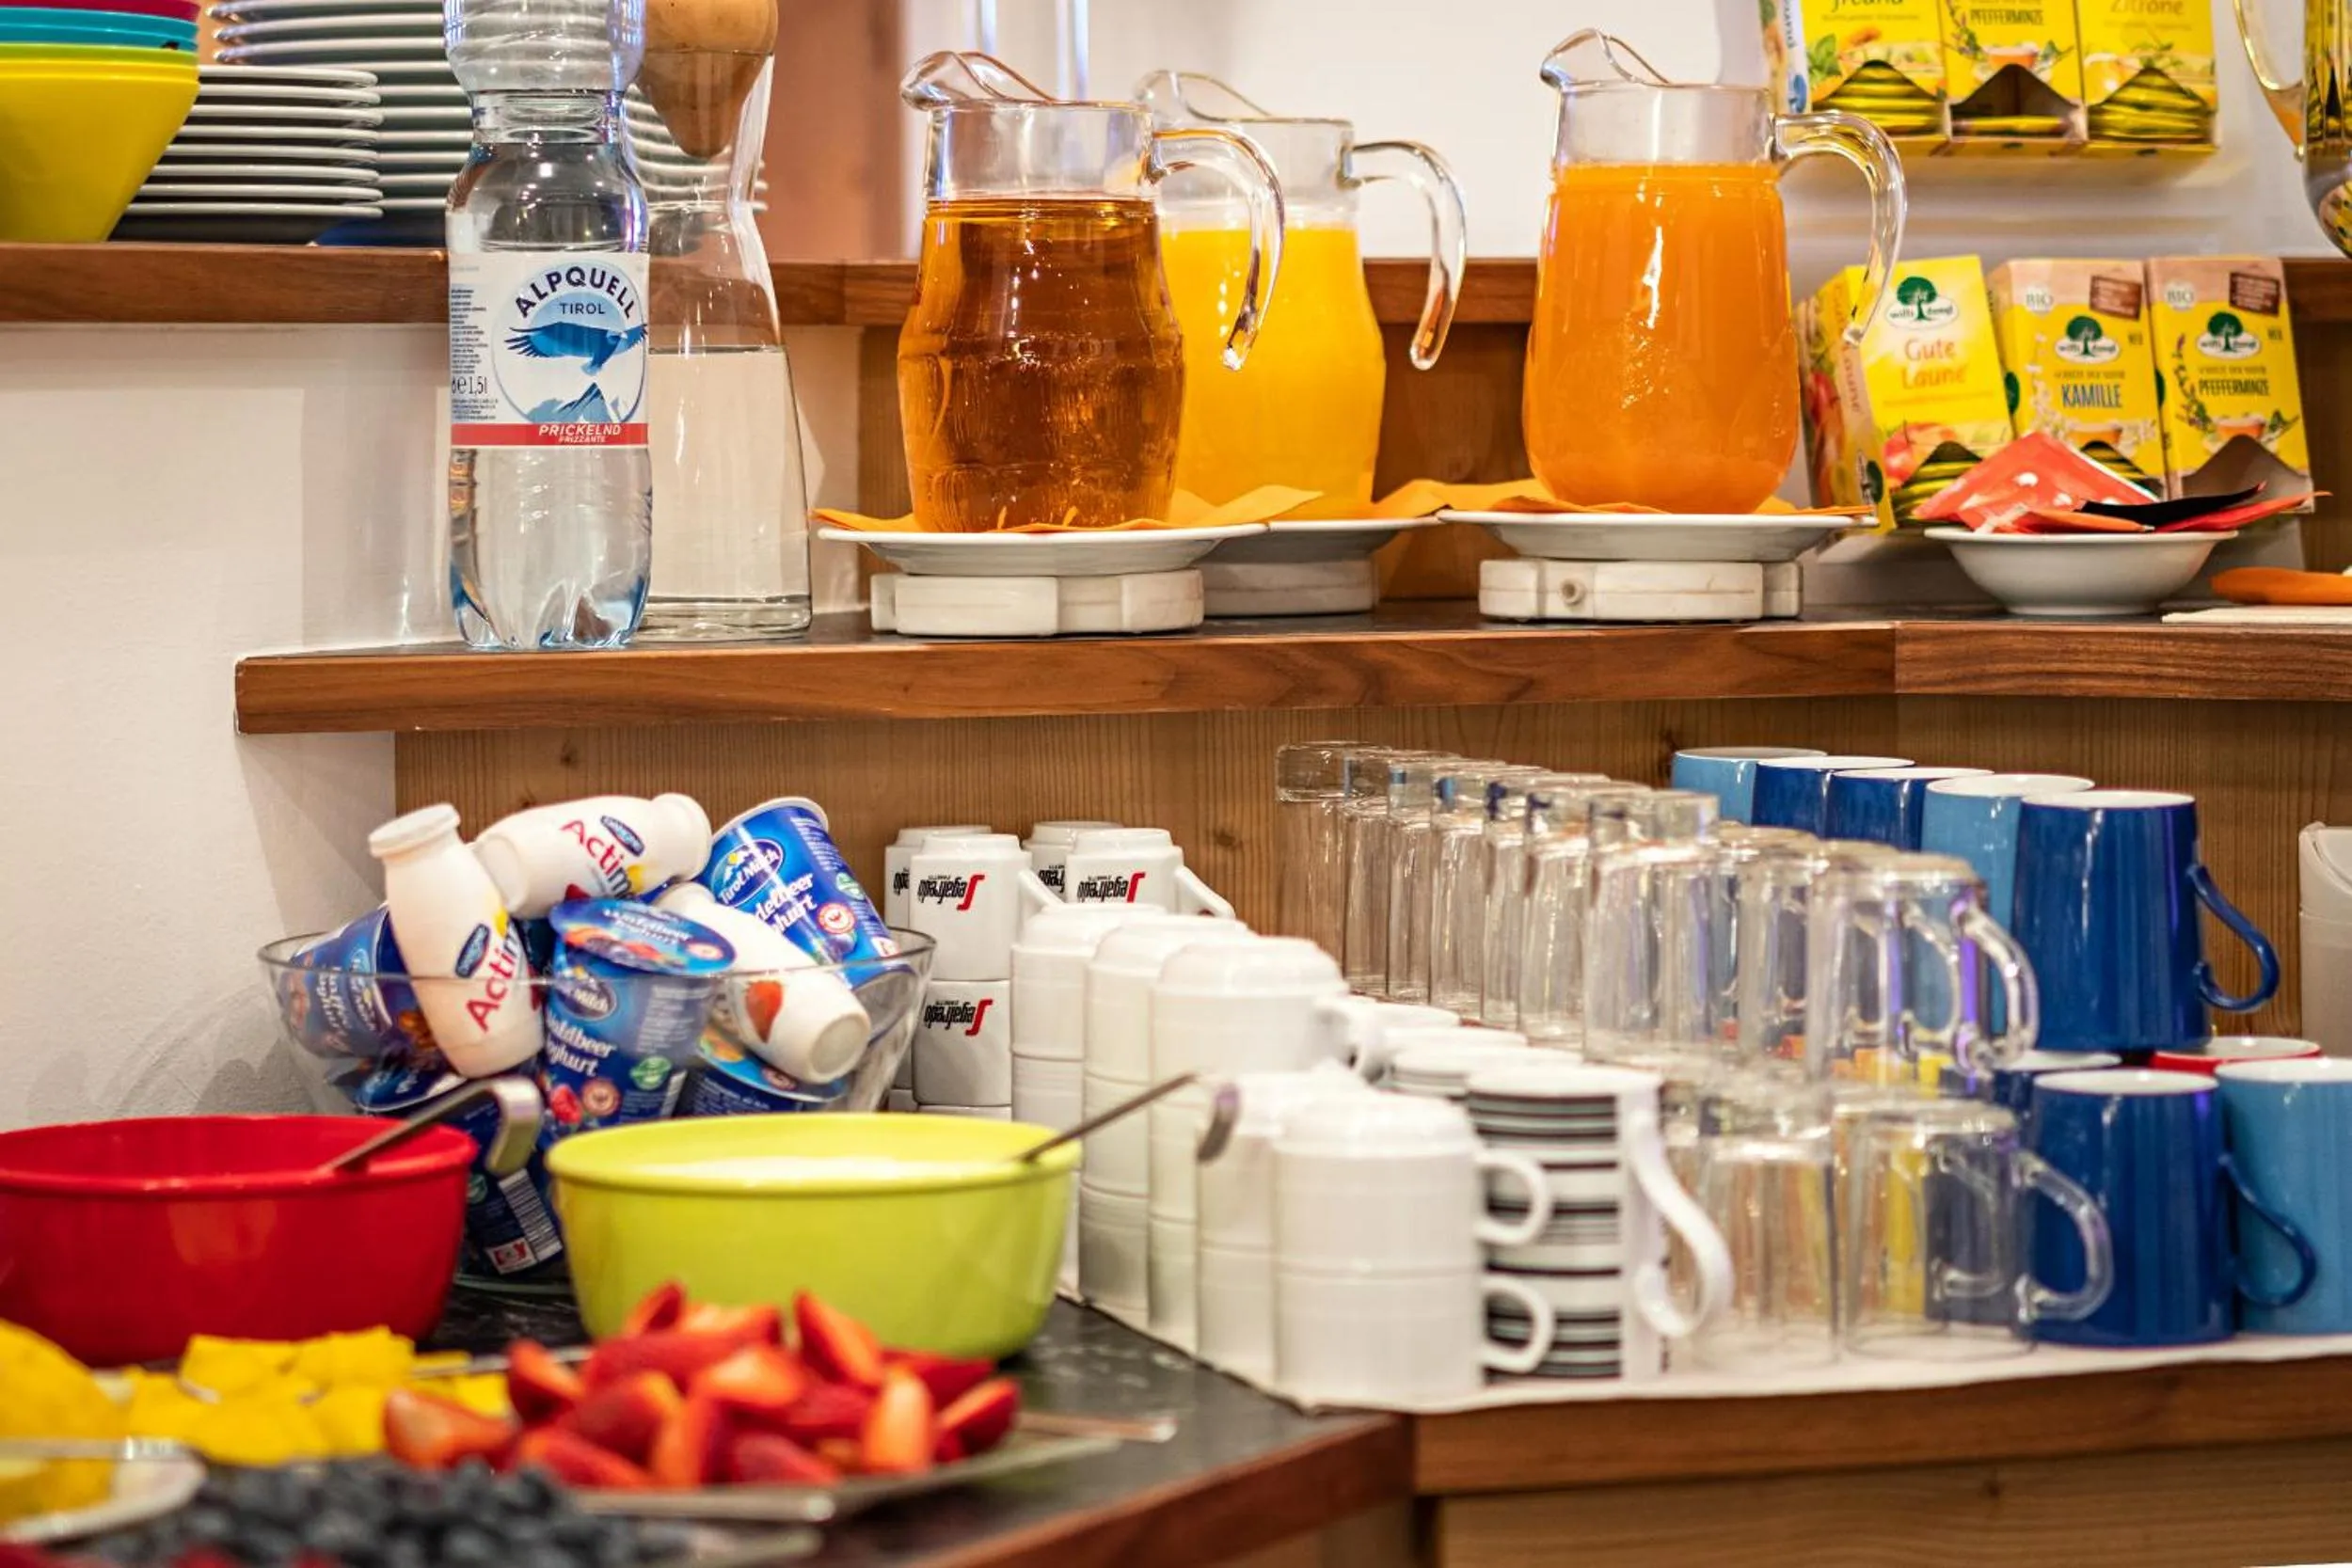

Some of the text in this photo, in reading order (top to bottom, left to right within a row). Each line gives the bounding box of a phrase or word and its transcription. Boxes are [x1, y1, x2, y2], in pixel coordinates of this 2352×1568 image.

[515, 266, 635, 318] ALPQUELL
[559, 302, 606, 315] TIROL
[1904, 339, 1957, 361] Gute
[1901, 363, 1968, 389] Laune
[2198, 378, 2270, 397] PFEFFERMINZE
[2061, 384, 2122, 408] KAMILLE
[538, 423, 622, 436] PRICKELND
[559, 819, 632, 898] Actim
